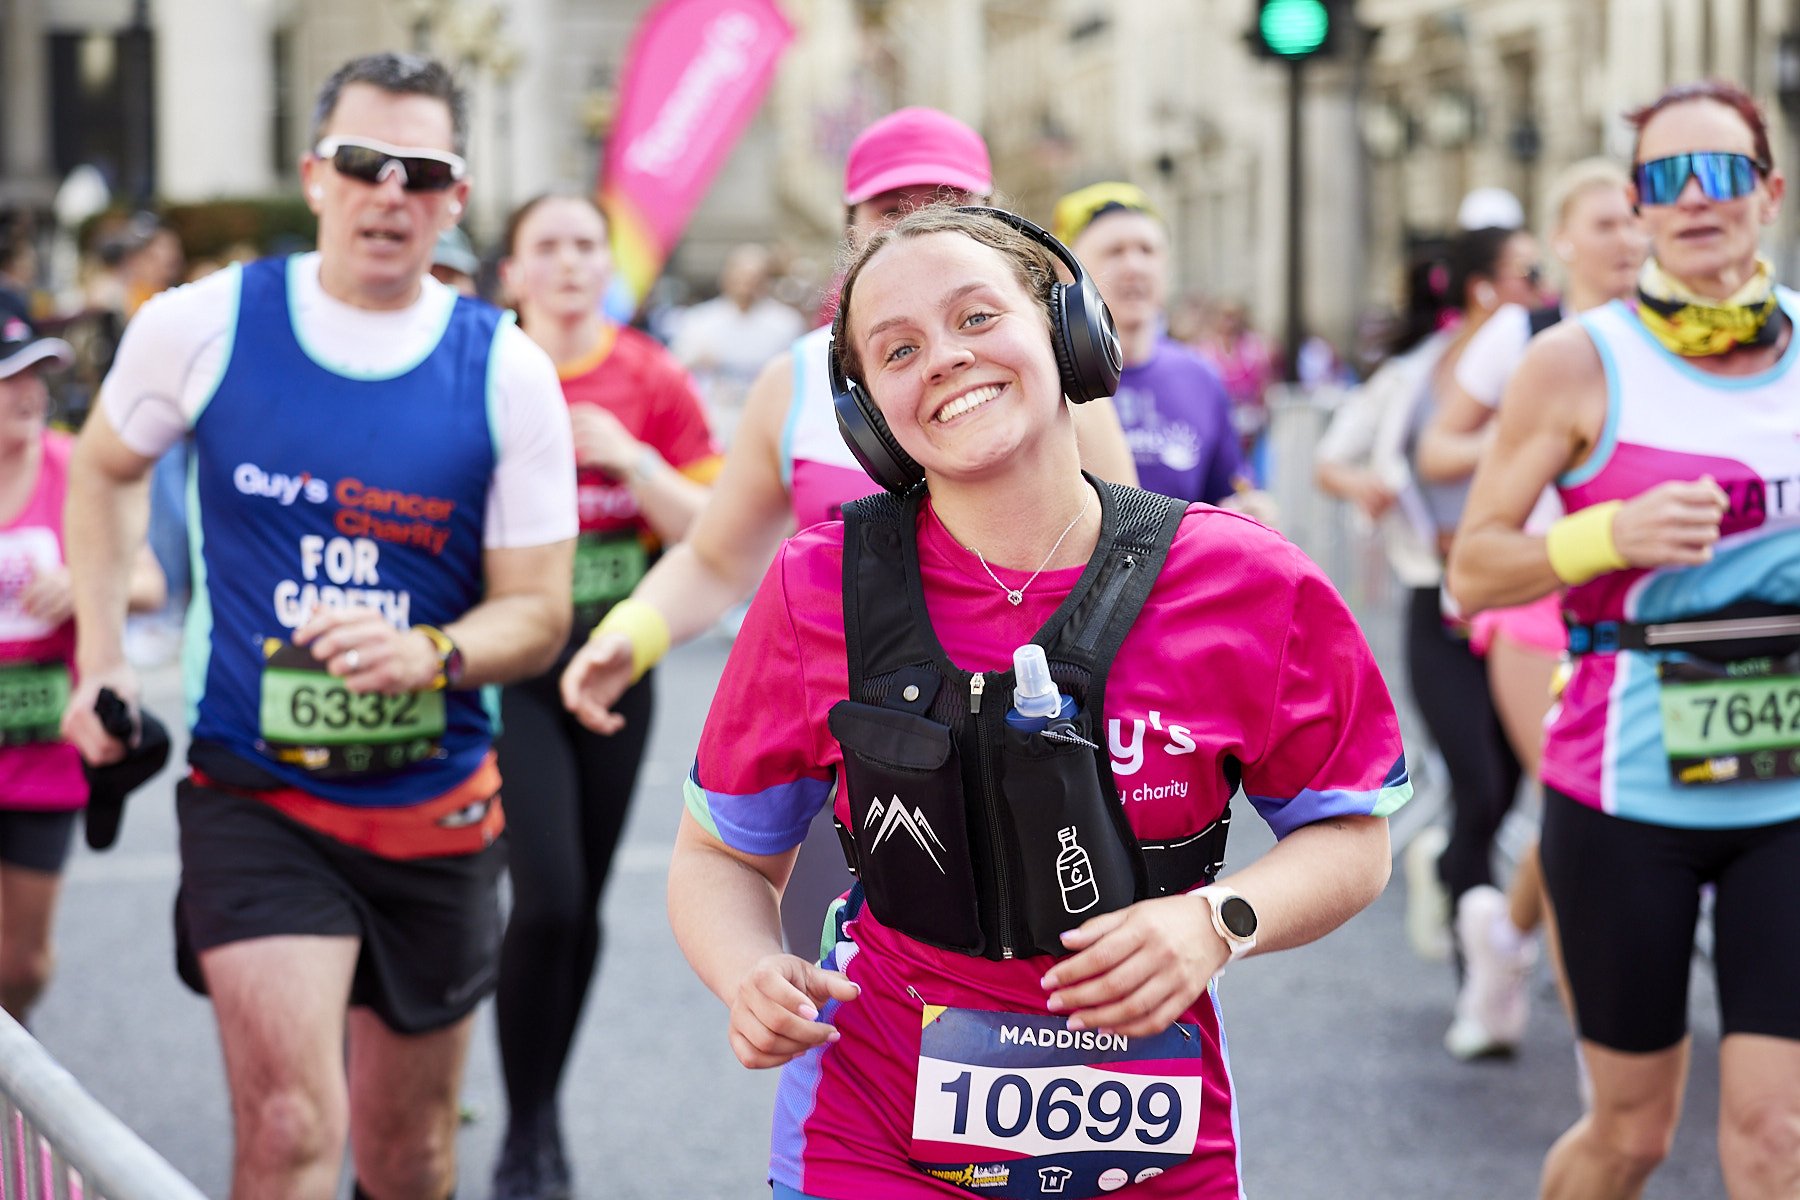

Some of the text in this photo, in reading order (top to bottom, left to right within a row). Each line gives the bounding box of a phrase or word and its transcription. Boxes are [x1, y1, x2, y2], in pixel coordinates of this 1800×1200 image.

[233, 463, 456, 521] Guy's Cancer
[335, 508, 453, 556] Charity
[300, 534, 380, 586] FOR
[290, 686, 420, 729] 6332
[1692, 687, 1800, 738] 7642
[1108, 710, 1197, 776] y's
[1132, 779, 1189, 802] charity
[1000, 1025, 1128, 1052] MADDISON
[941, 1071, 1182, 1145] 10699
